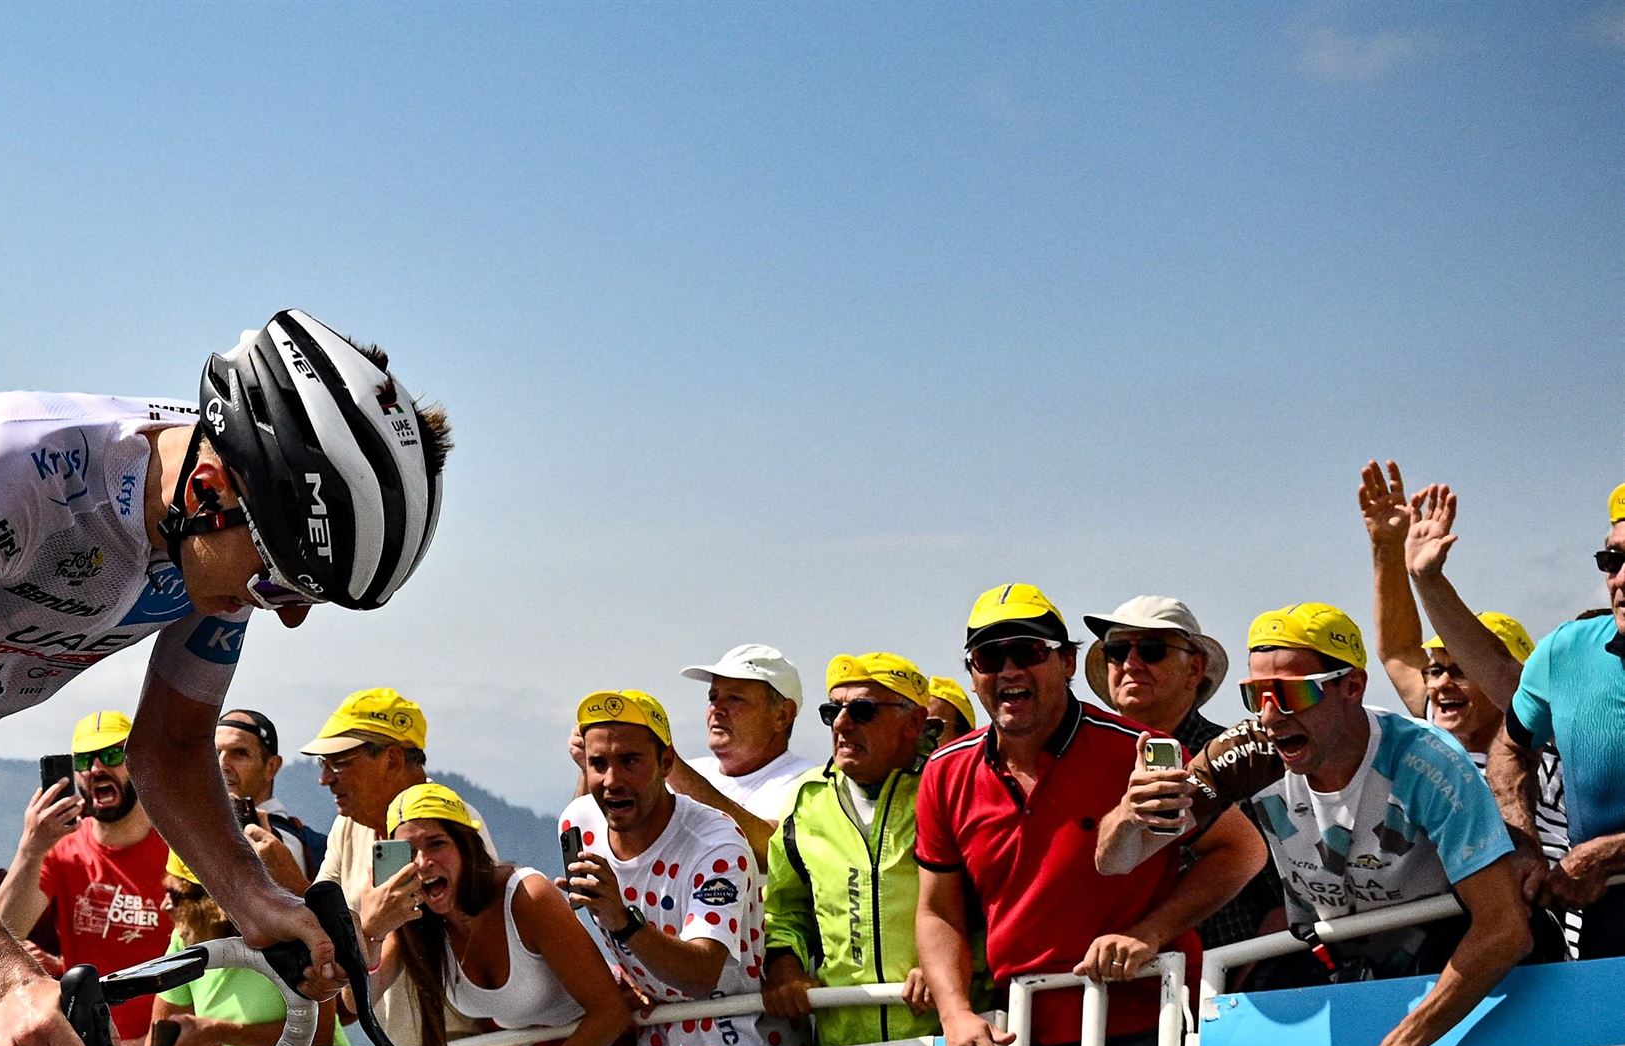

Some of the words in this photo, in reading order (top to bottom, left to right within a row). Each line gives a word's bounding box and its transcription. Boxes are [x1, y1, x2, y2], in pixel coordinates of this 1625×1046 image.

[283, 341, 320, 383] MET
[391, 419, 412, 431] UAE
[31, 447, 81, 480] Krys
[121, 475, 136, 516] Krys
[305, 473, 332, 563] MET
[5, 625, 134, 652] UAE
[1331, 632, 1348, 644] LCL
[891, 669, 909, 679] LCL
[372, 711, 389, 721] LCL
[588, 705, 602, 713] LCL
[115, 894, 142, 910] SEB
[109, 908, 159, 926] OGIER
